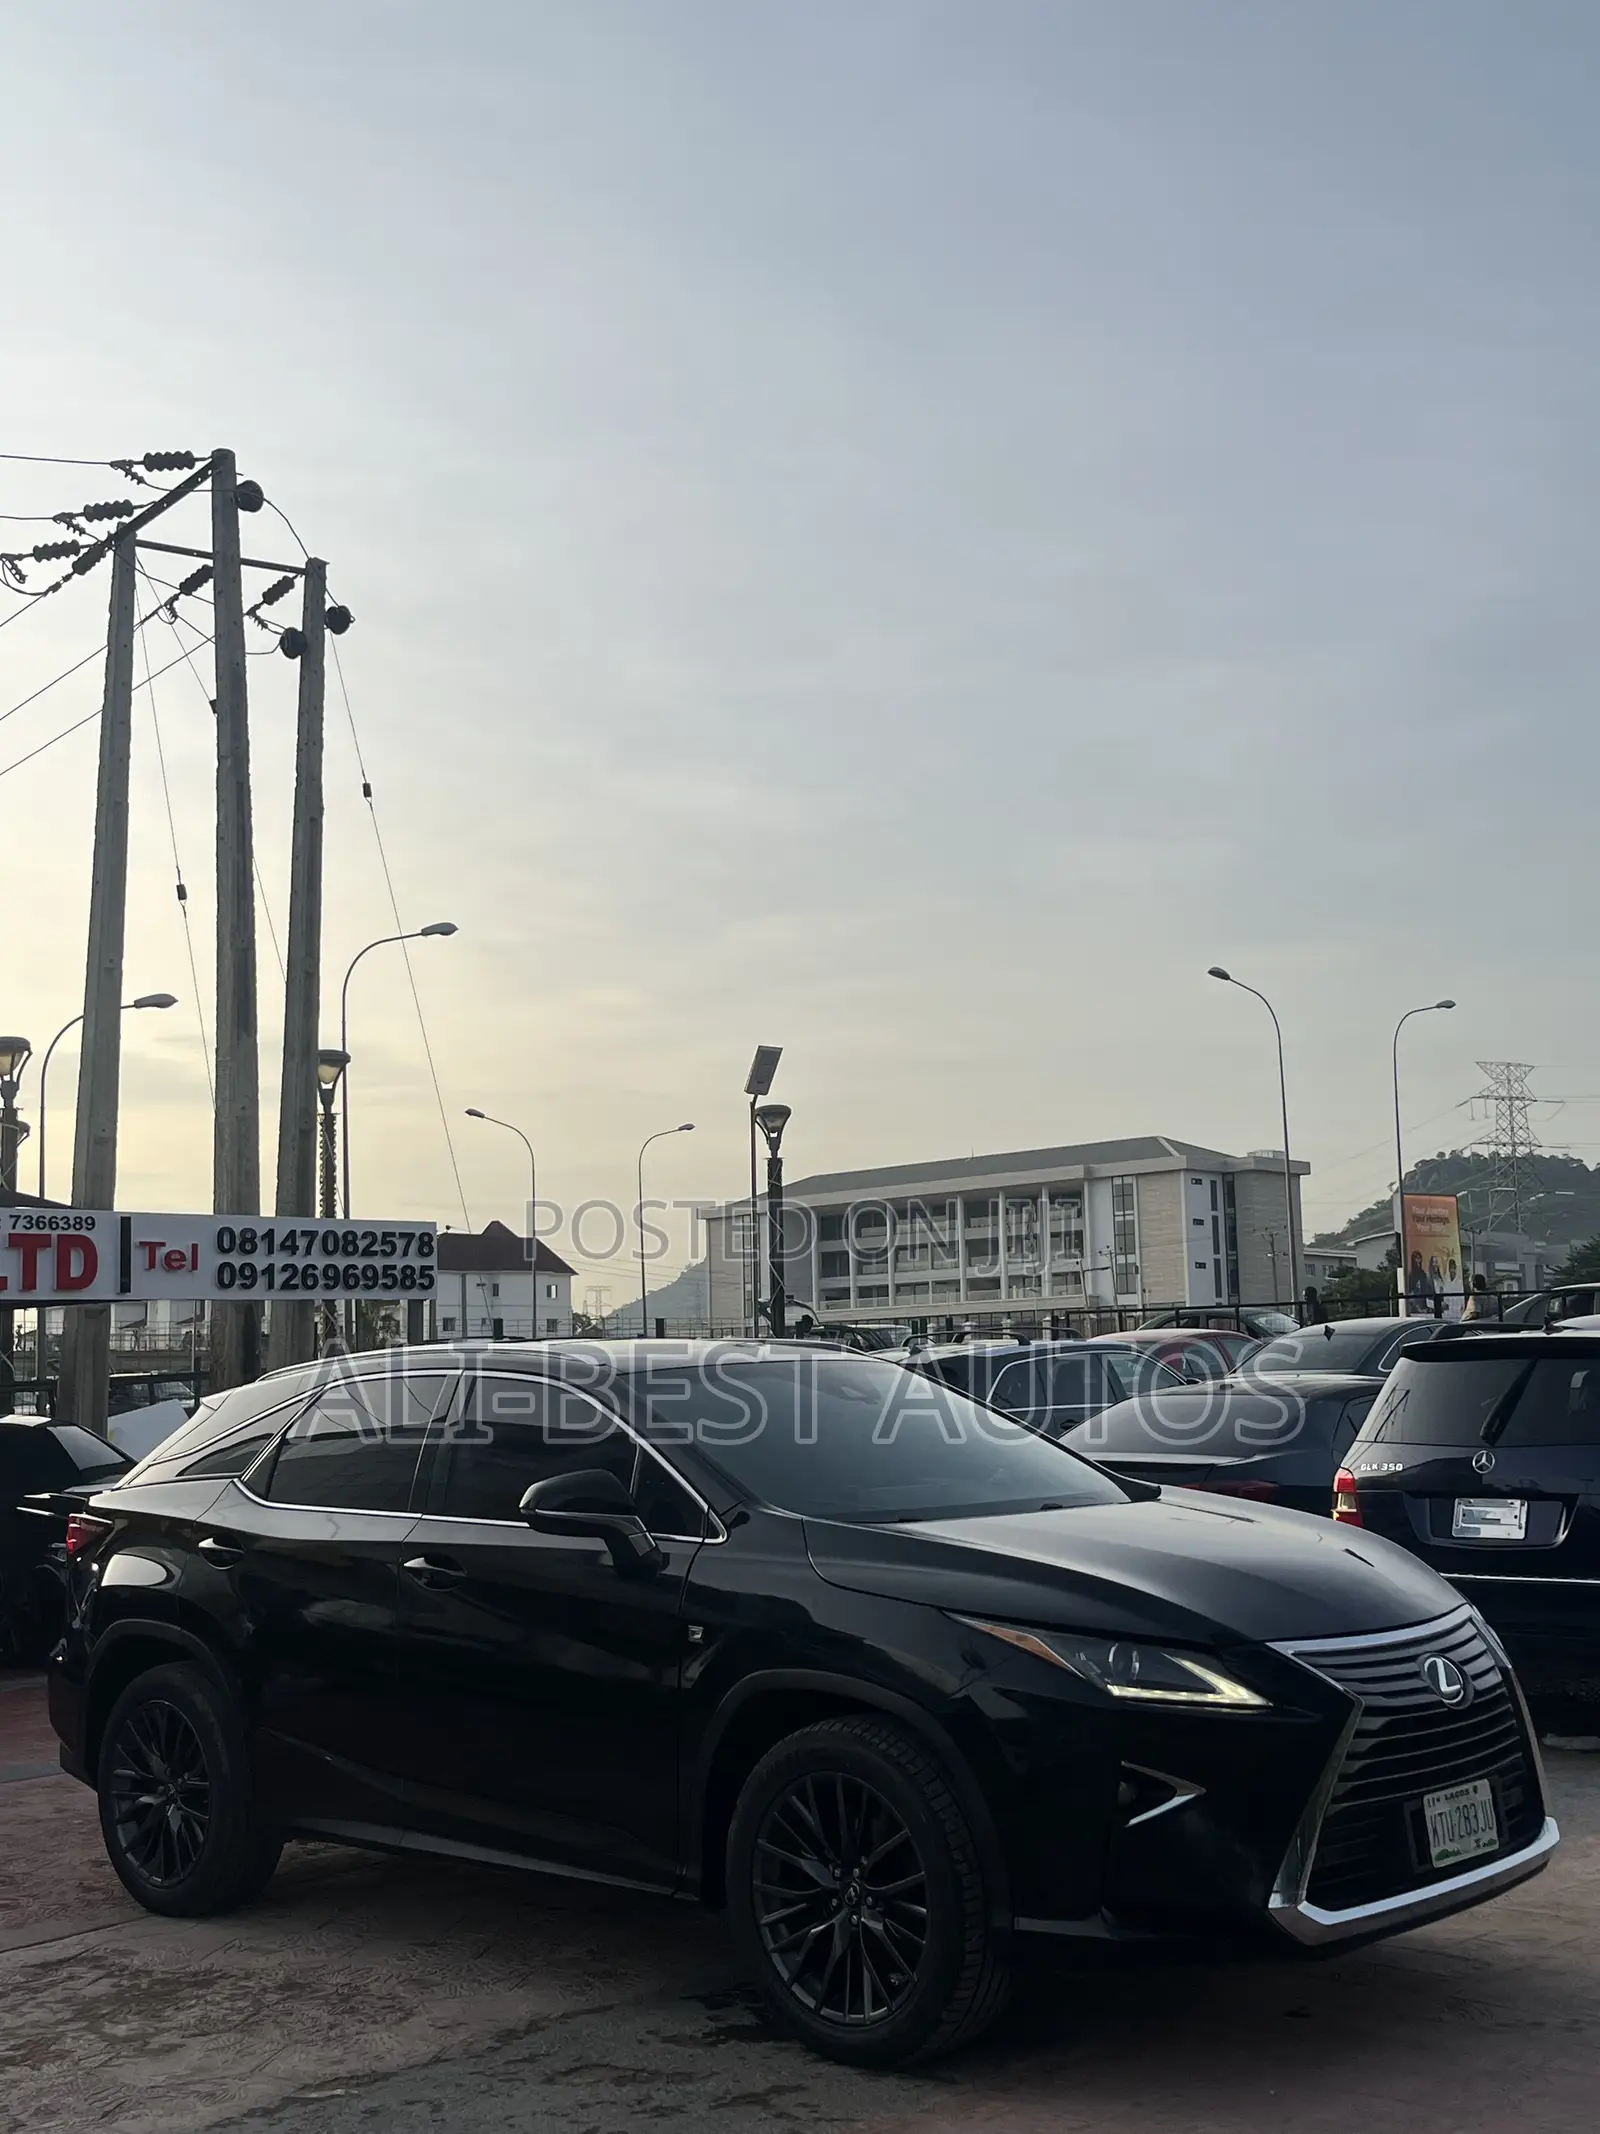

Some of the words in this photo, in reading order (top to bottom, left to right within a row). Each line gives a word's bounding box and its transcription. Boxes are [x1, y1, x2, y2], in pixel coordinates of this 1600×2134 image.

[9, 1214, 96, 1231] 7366389
[138, 1241, 199, 1272] Tel
[216, 1226, 435, 1258] 08147082578
[0, 1233, 98, 1292] TD
[216, 1261, 436, 1291] 09126969585
[1360, 1463, 1378, 1471] GLK
[1381, 1463, 1403, 1471] 350
